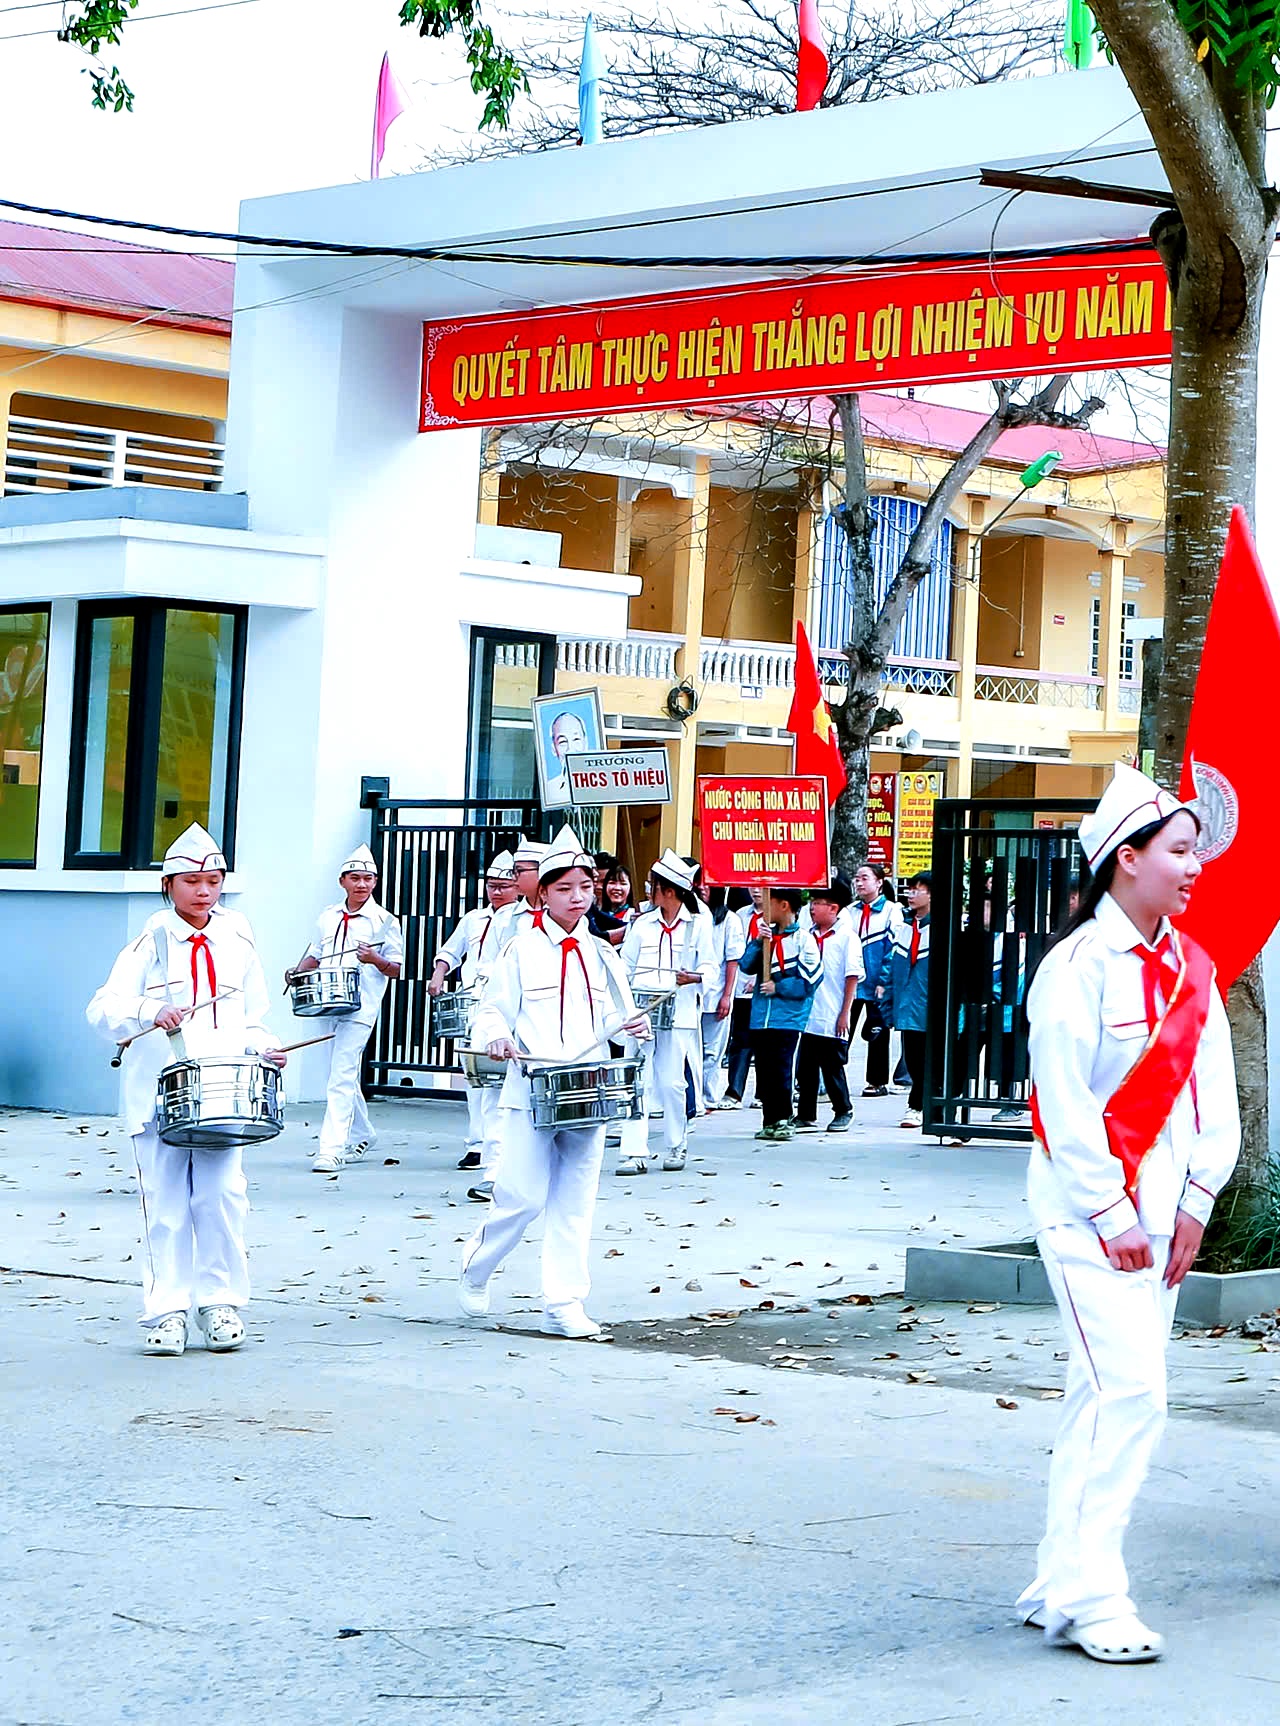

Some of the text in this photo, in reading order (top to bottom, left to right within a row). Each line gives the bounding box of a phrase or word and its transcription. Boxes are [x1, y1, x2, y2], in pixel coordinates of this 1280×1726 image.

[452, 333, 529, 404] QUYẾT
[537, 334, 593, 394] TÂM
[602, 329, 669, 390] THỰC
[677, 317, 742, 388] HIỆN
[752, 298, 846, 371] THẮNG
[855, 304, 902, 373] LỢI
[910, 287, 1014, 366] NHIỆM
[1024, 289, 1065, 356] VỤ
[1075, 272, 1154, 340] NĂM
[572, 767, 665, 788] THCS TÔ HIỆU
[704, 785, 820, 815] NƯỚC CỘNG HÒA XÃ HỘI
[712, 813, 815, 845] CHỦ NGHĨA VIỆT NAM
[733, 849, 763, 872] MUÔN
[765, 849, 789, 872] NĂM
